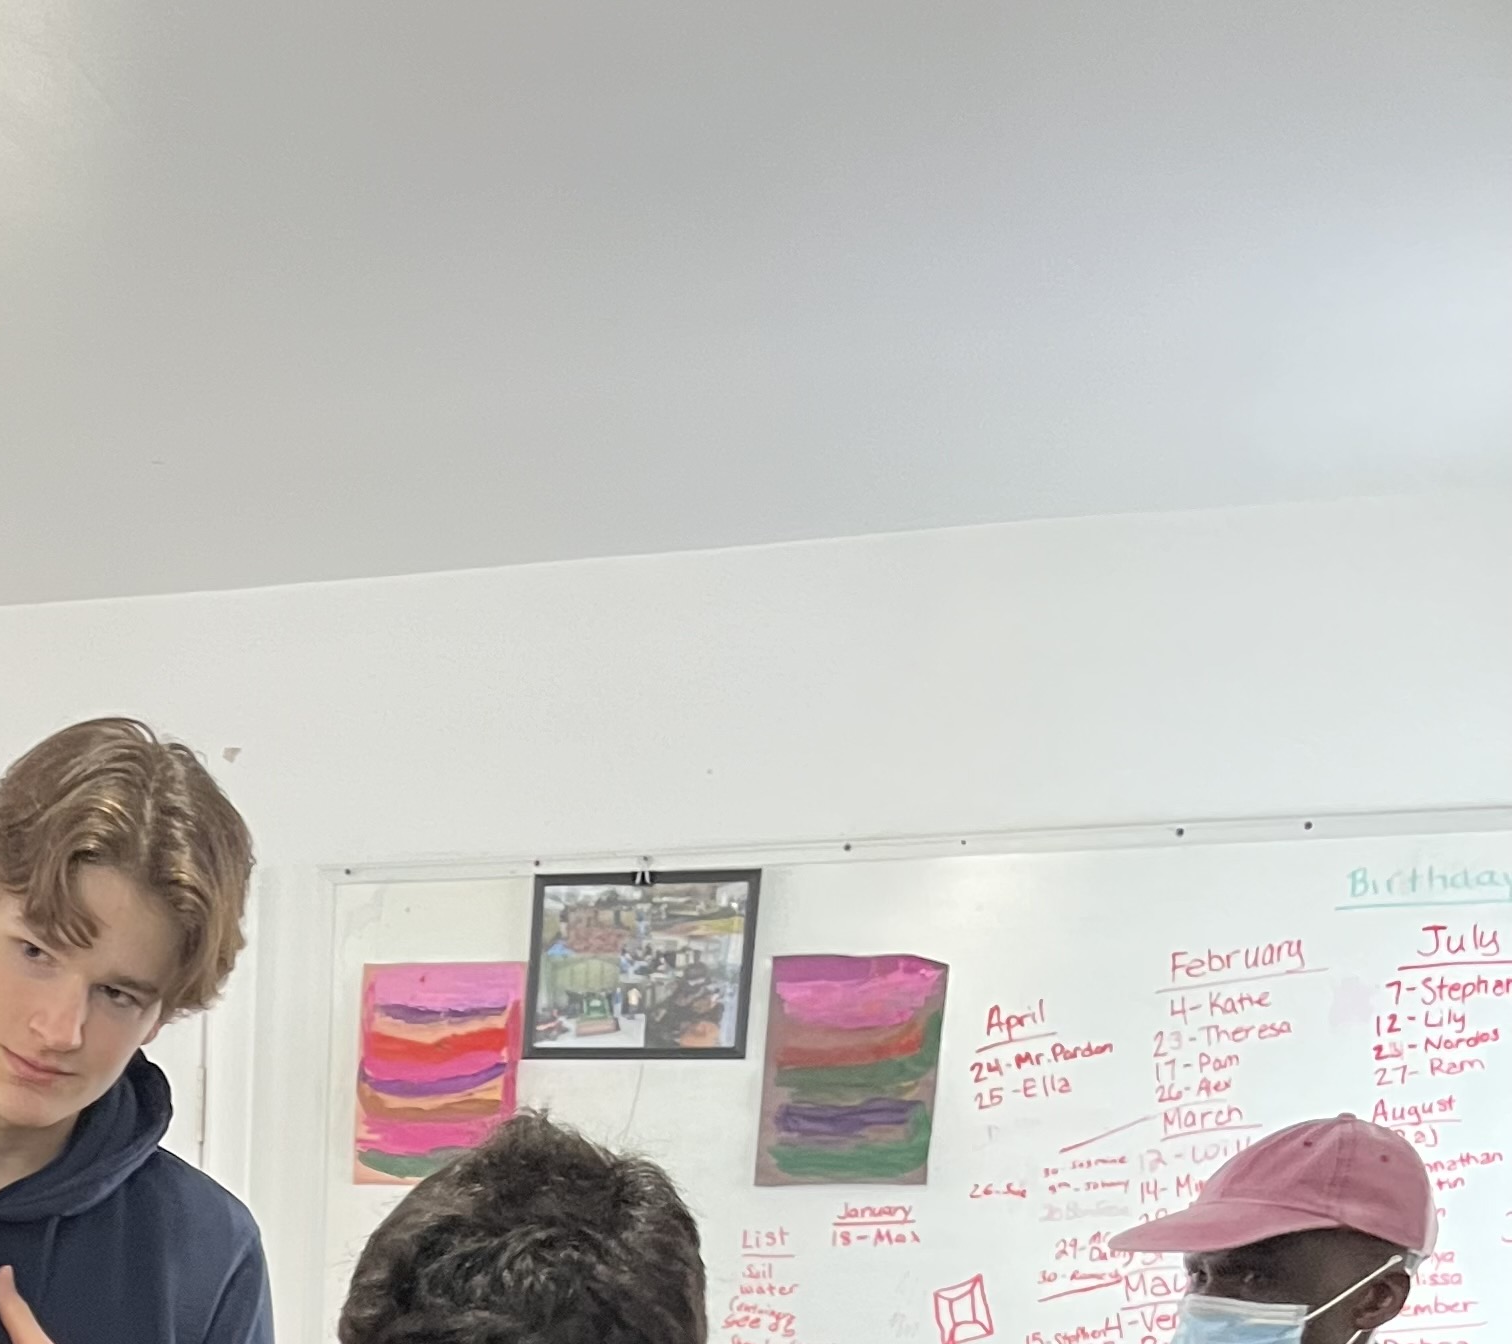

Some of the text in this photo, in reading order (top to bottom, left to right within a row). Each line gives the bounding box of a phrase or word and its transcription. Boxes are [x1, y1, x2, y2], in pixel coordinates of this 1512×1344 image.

[1416, 923, 1500, 957] July
[1170, 939, 1306, 982] February
[986, 998, 1045, 1041] April
[1163, 1105, 1243, 1135] March
[1372, 1094, 1455, 1126] August
[837, 1202, 913, 1224] January
[741, 1226, 790, 1249] List
[739, 1283, 800, 1297] water
[1399, 1295, 1479, 1318] ember
